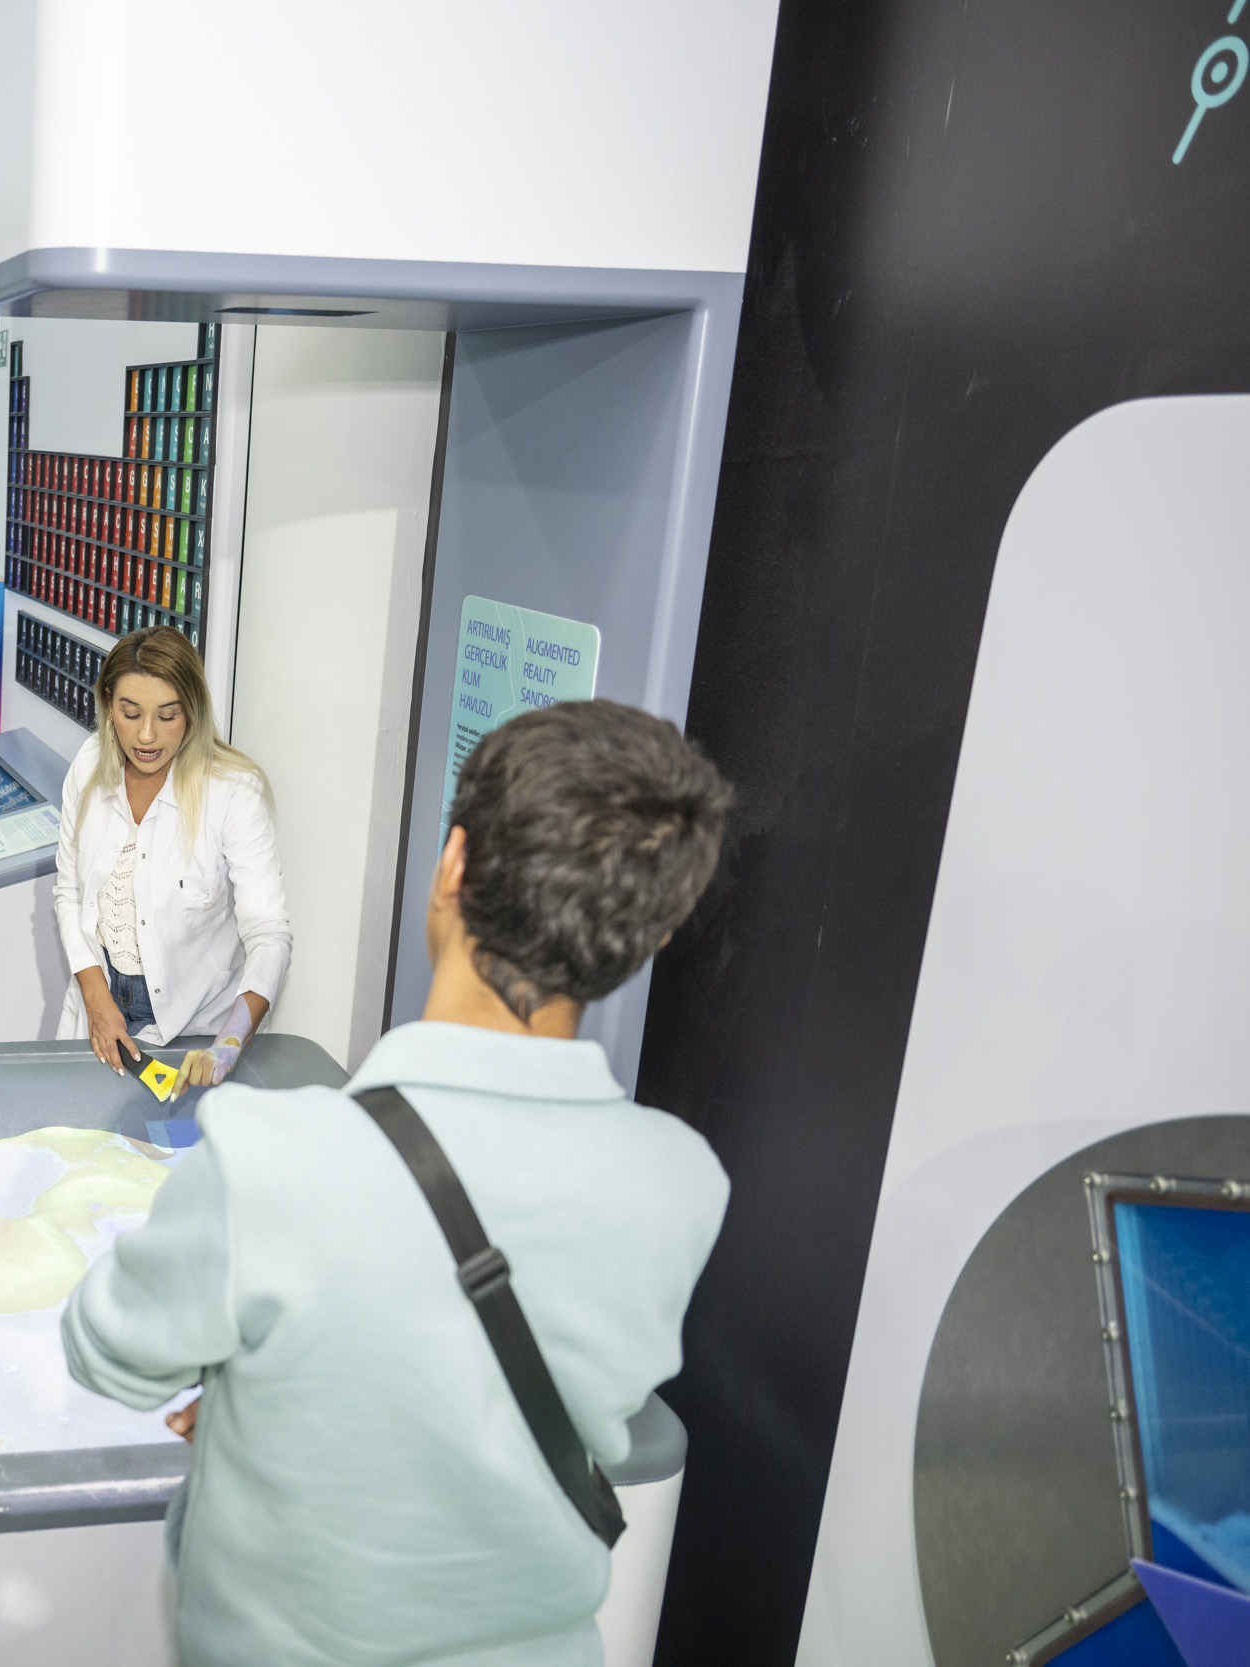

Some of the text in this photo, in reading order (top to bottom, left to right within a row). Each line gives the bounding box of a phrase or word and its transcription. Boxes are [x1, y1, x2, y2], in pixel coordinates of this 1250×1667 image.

[467, 619, 511, 649] ARTIRILMIŞ
[464, 644, 508, 672] GERÇEKLİK
[526, 637, 581, 666] AUGMENTED
[462, 668, 481, 689] KUM
[523, 662, 557, 686] REALITY
[459, 693, 492, 718] HAVUZU
